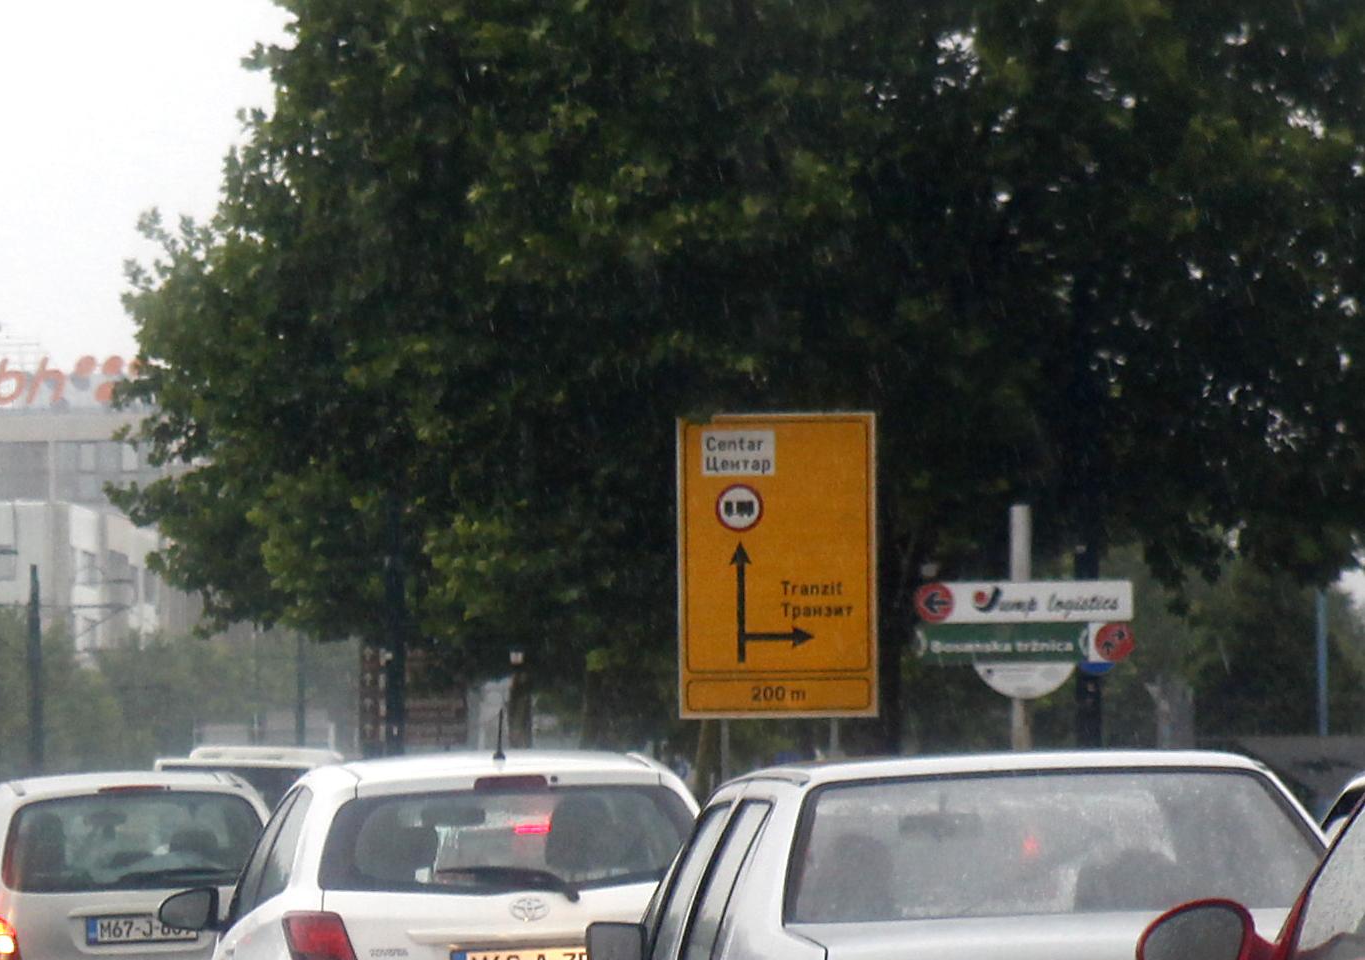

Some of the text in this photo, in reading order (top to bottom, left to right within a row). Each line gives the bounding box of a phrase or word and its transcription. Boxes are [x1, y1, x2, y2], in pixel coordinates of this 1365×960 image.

[706, 437, 764, 451] Centar
[706, 458, 771, 474] Центар
[780, 581, 844, 596] Tranzit
[780, 602, 854, 621] Транзит
[751, 687, 806, 701] 200 m
